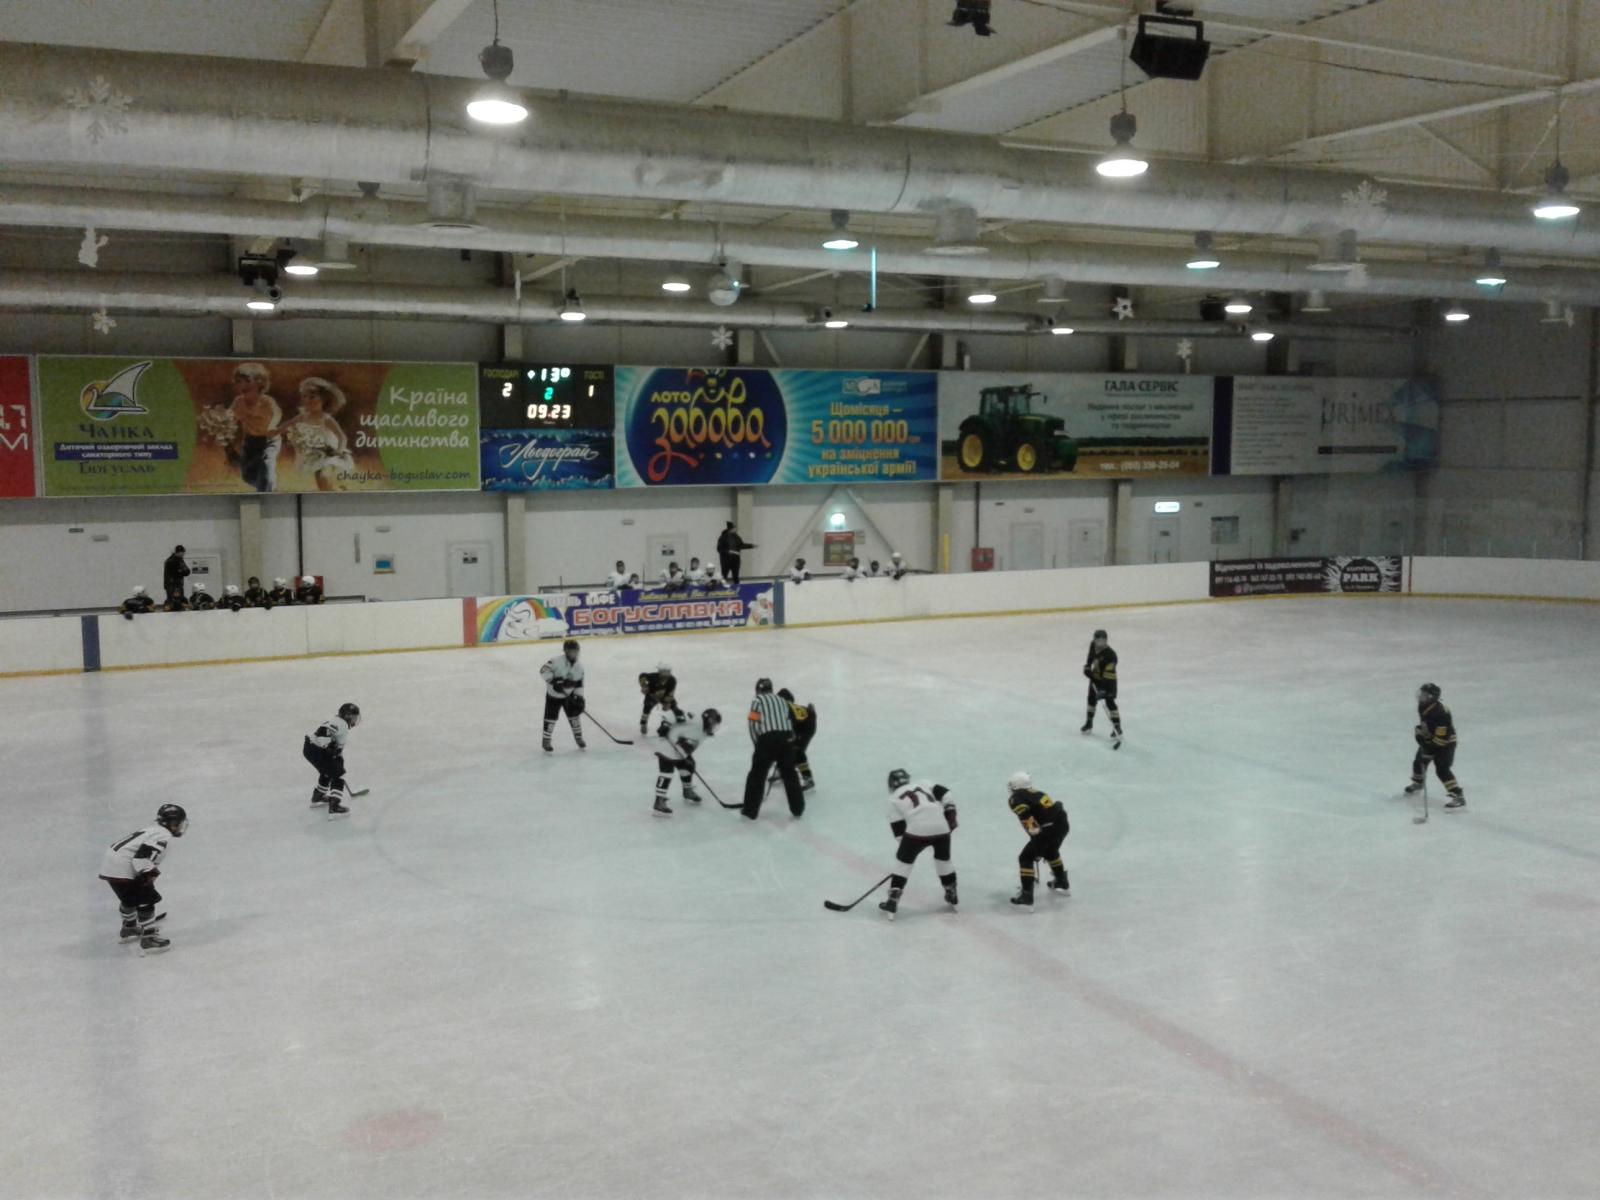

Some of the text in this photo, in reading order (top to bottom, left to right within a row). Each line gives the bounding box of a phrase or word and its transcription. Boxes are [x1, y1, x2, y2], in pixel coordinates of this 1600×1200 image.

[502, 382, 513, 397] 2
[544, 387, 554, 400] 2
[588, 385, 595, 397] 1
[1105, 380, 1136, 392] ГАЛА
[390, 386, 468, 411] Країна
[652, 391, 691, 403] ЛОТО
[360, 409, 469, 430] щасливого
[355, 430, 469, 448] дитинства
[812, 420, 824, 444] 5
[828, 420, 866, 444] 000
[872, 420, 908, 444] 000
[821, 450, 836, 460] на
[337, 468, 471, 484] chayka-boguslav.com
[808, 461, 878, 478] української
[1342, 573, 1379, 582] PARK
[573, 600, 744, 626] БОГУСЛАВНА
